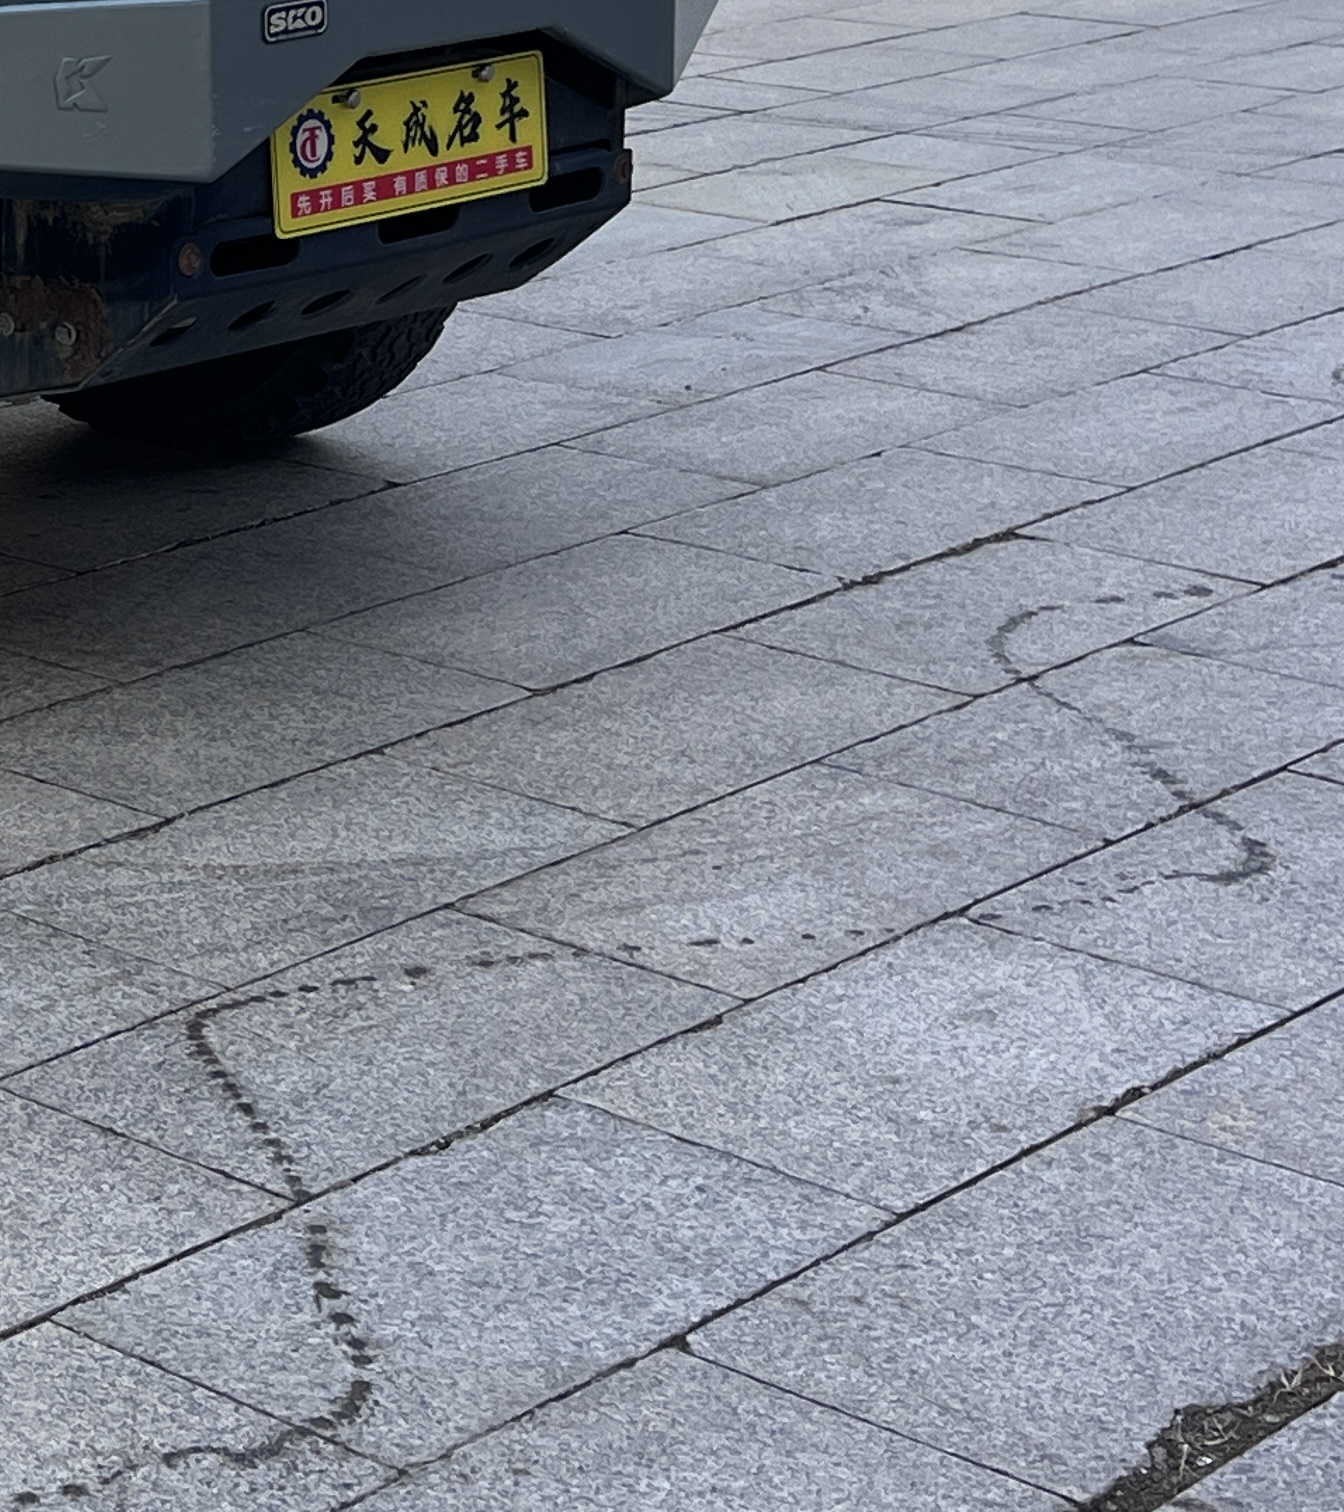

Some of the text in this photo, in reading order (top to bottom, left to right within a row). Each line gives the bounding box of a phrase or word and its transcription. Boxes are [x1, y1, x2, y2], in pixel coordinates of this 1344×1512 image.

[352, 77, 531, 166] 天成名车
[296, 150, 530, 217] 先开后买 有质保的二手车
